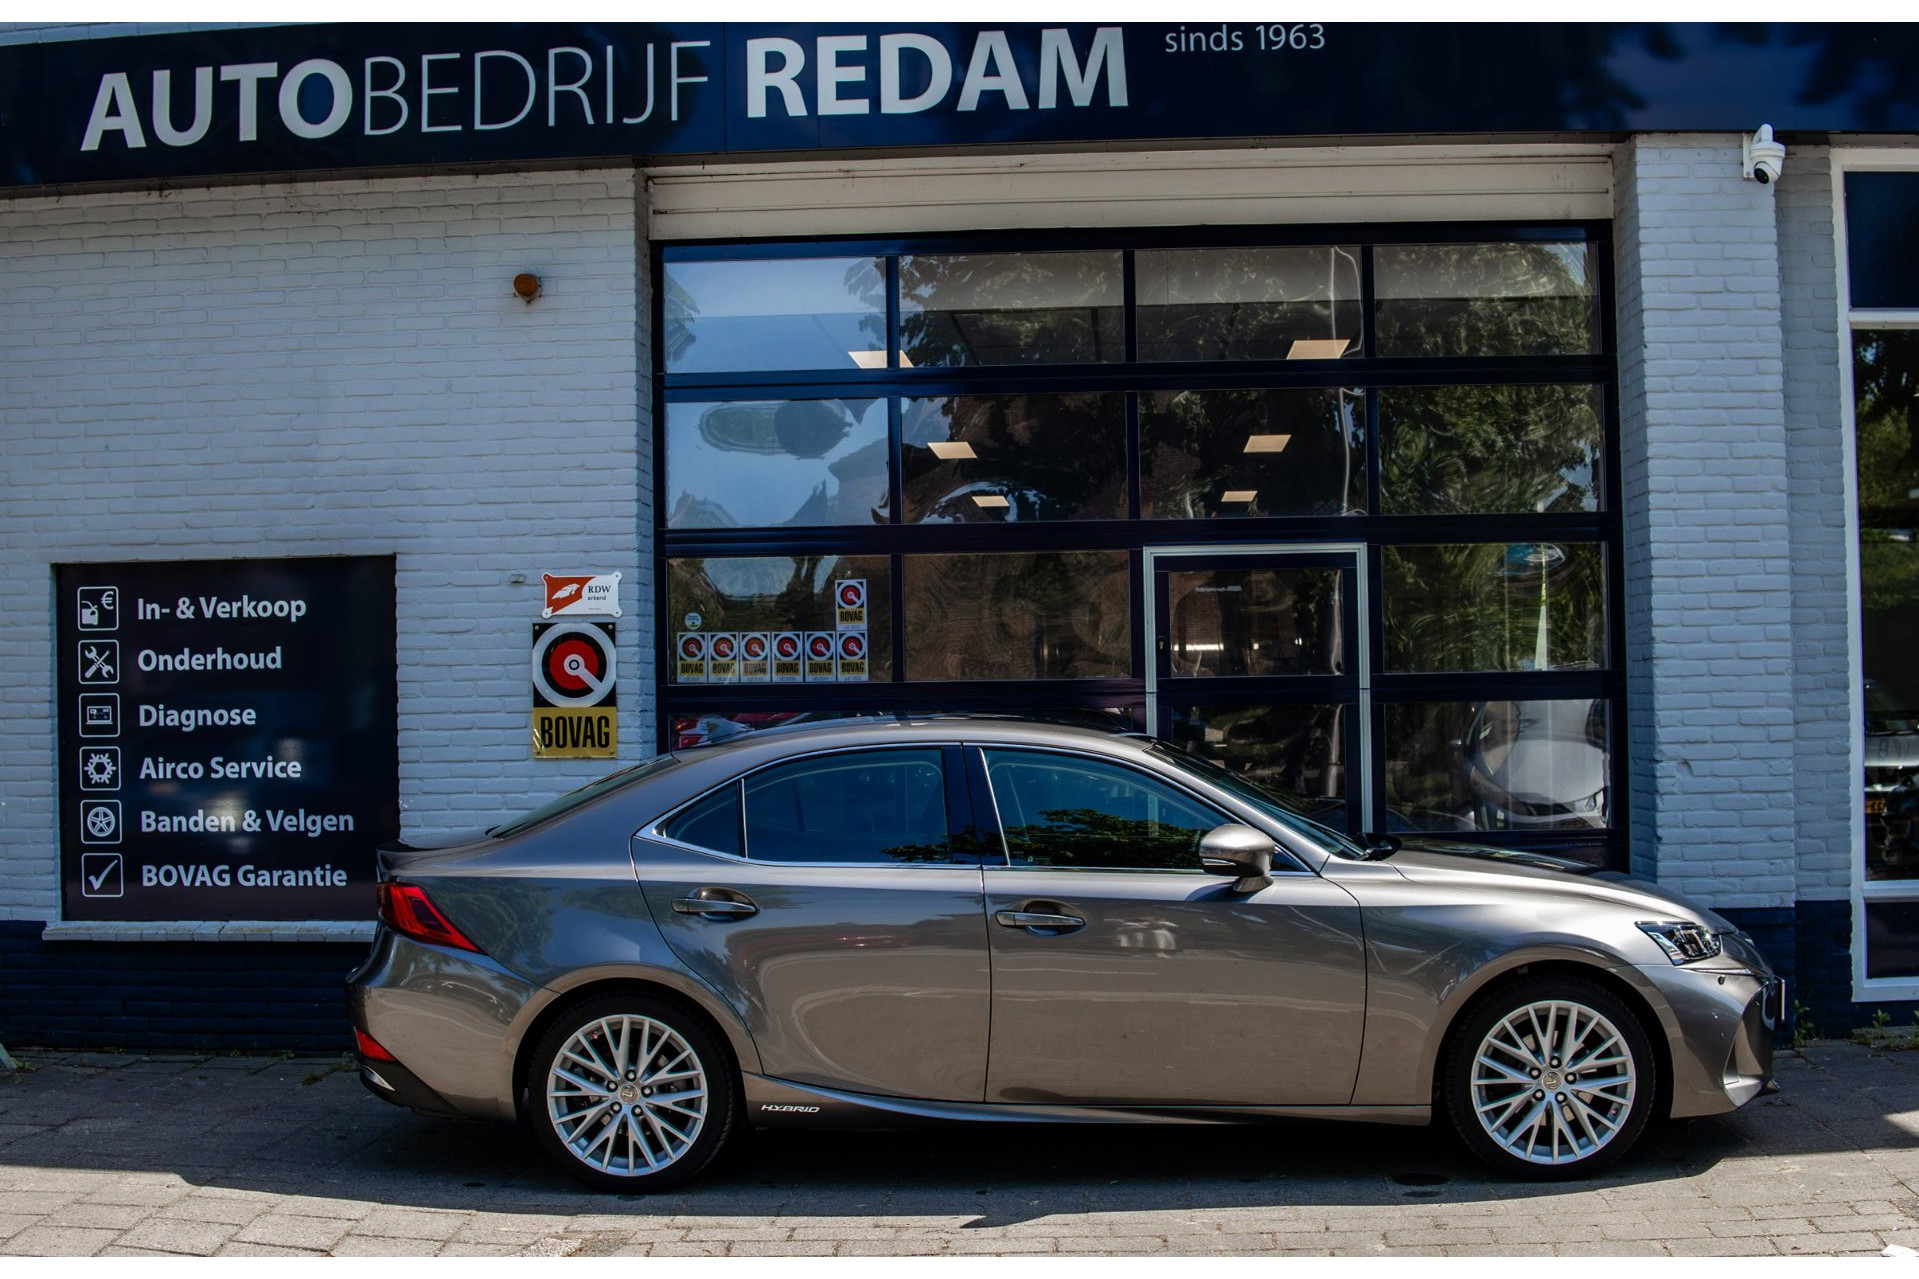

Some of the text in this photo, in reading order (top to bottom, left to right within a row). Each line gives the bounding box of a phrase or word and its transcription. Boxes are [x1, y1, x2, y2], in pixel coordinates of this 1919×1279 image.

[1164, 23, 1326, 53] sinds 1963
[80, 26, 1129, 152] AUTOBEDRIJF REDAM
[588, 585, 611, 594] RDW
[138, 595, 307, 622] In- & Verkoop
[840, 610, 863, 622] BOVAG
[138, 646, 282, 672] Onderhoud
[681, 662, 704, 674] BOVAG
[712, 662, 735, 674] BOVAG
[776, 661, 799, 674] BOVAG
[808, 661, 832, 673] BOVAG
[841, 661, 865, 673] BOVAG
[139, 704, 257, 731] Diagnose
[540, 715, 610, 749] BOVAG
[139, 755, 302, 779] Airco Service
[141, 809, 354, 837] Banden & Velgen
[142, 864, 347, 887] BOVAG Garantie
[761, 1104, 821, 1113] HYBRID
